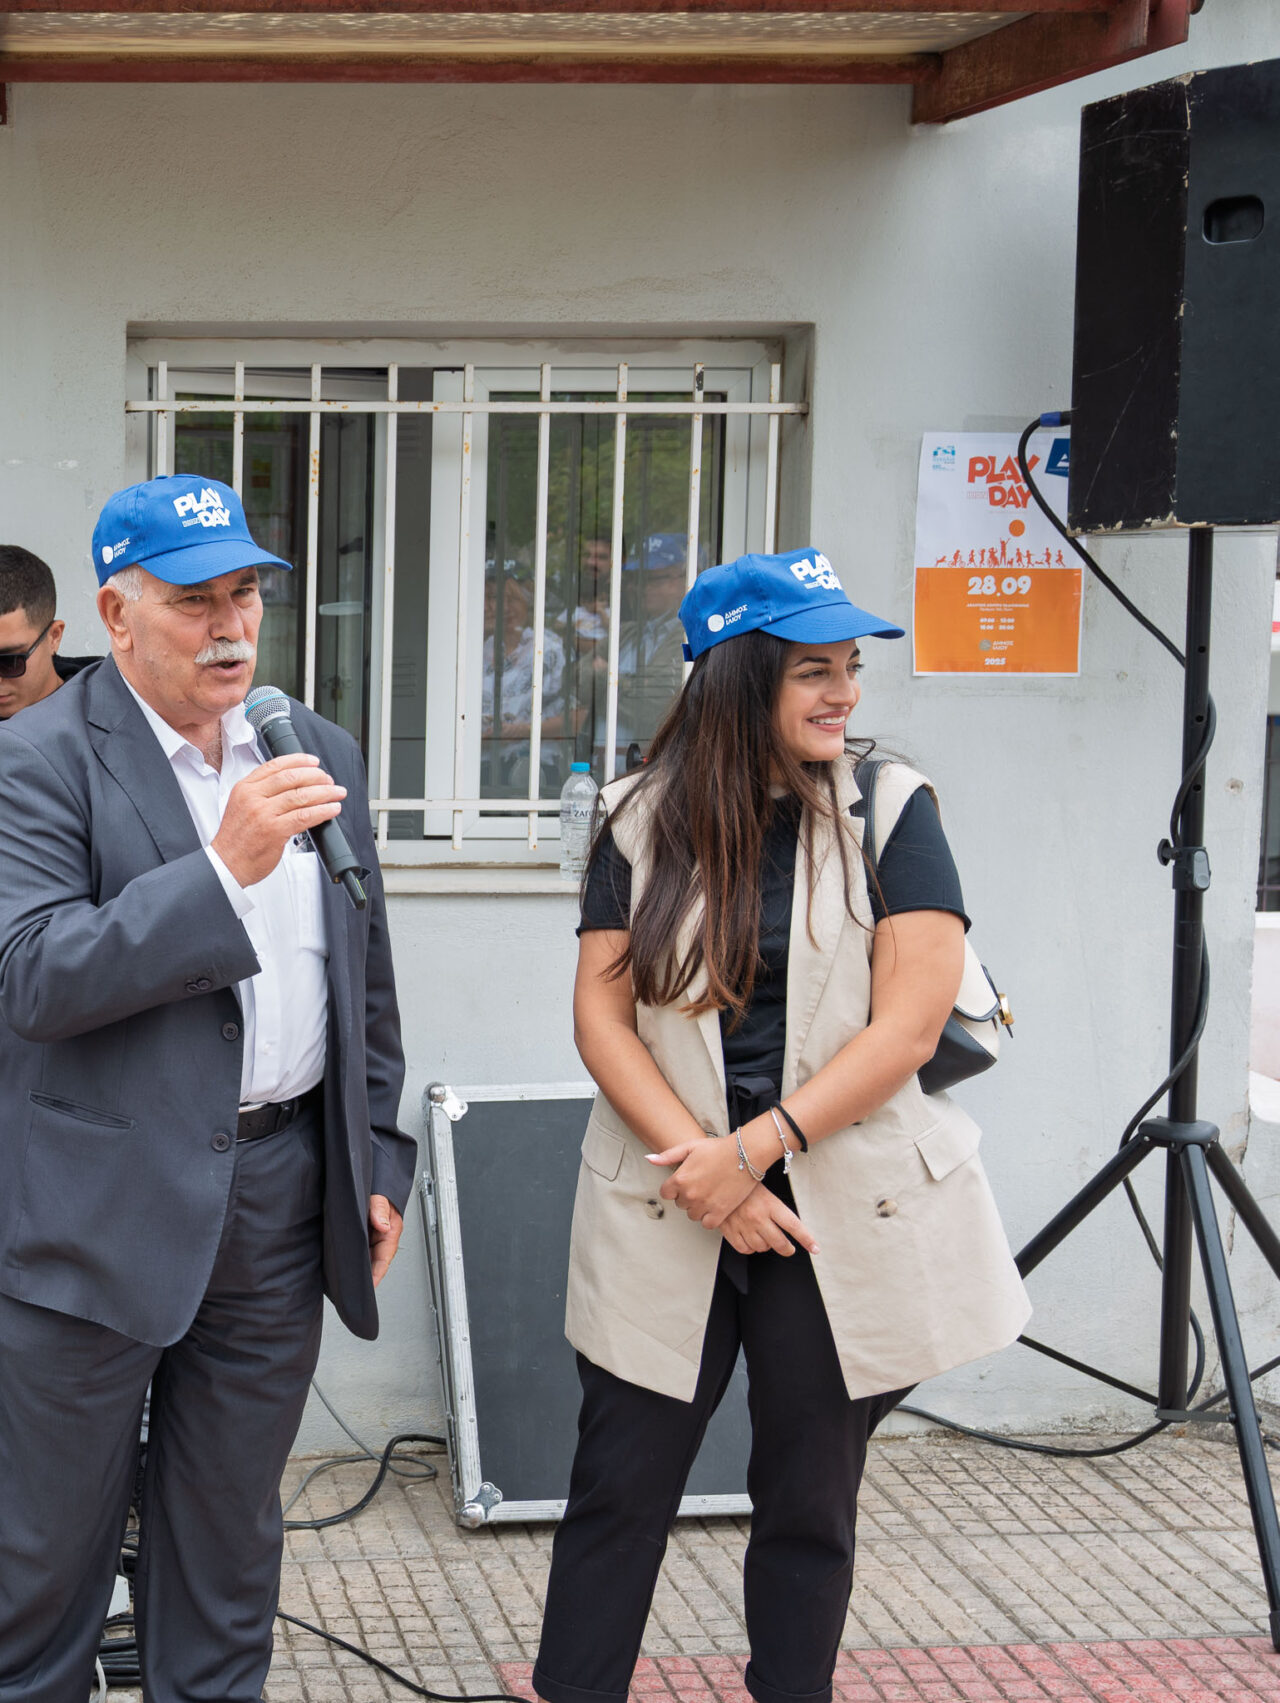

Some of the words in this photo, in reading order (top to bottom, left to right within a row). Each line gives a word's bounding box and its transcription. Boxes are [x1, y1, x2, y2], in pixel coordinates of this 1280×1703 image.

[967, 454, 1041, 484] PLAY
[173, 487, 224, 518] PLAY
[988, 484, 1033, 509] DAY
[197, 507, 231, 528] DAY
[967, 575, 1032, 597] 28.09
[725, 604, 748, 619] ΔΗΜΟΣ
[984, 657, 1006, 665] 2025
